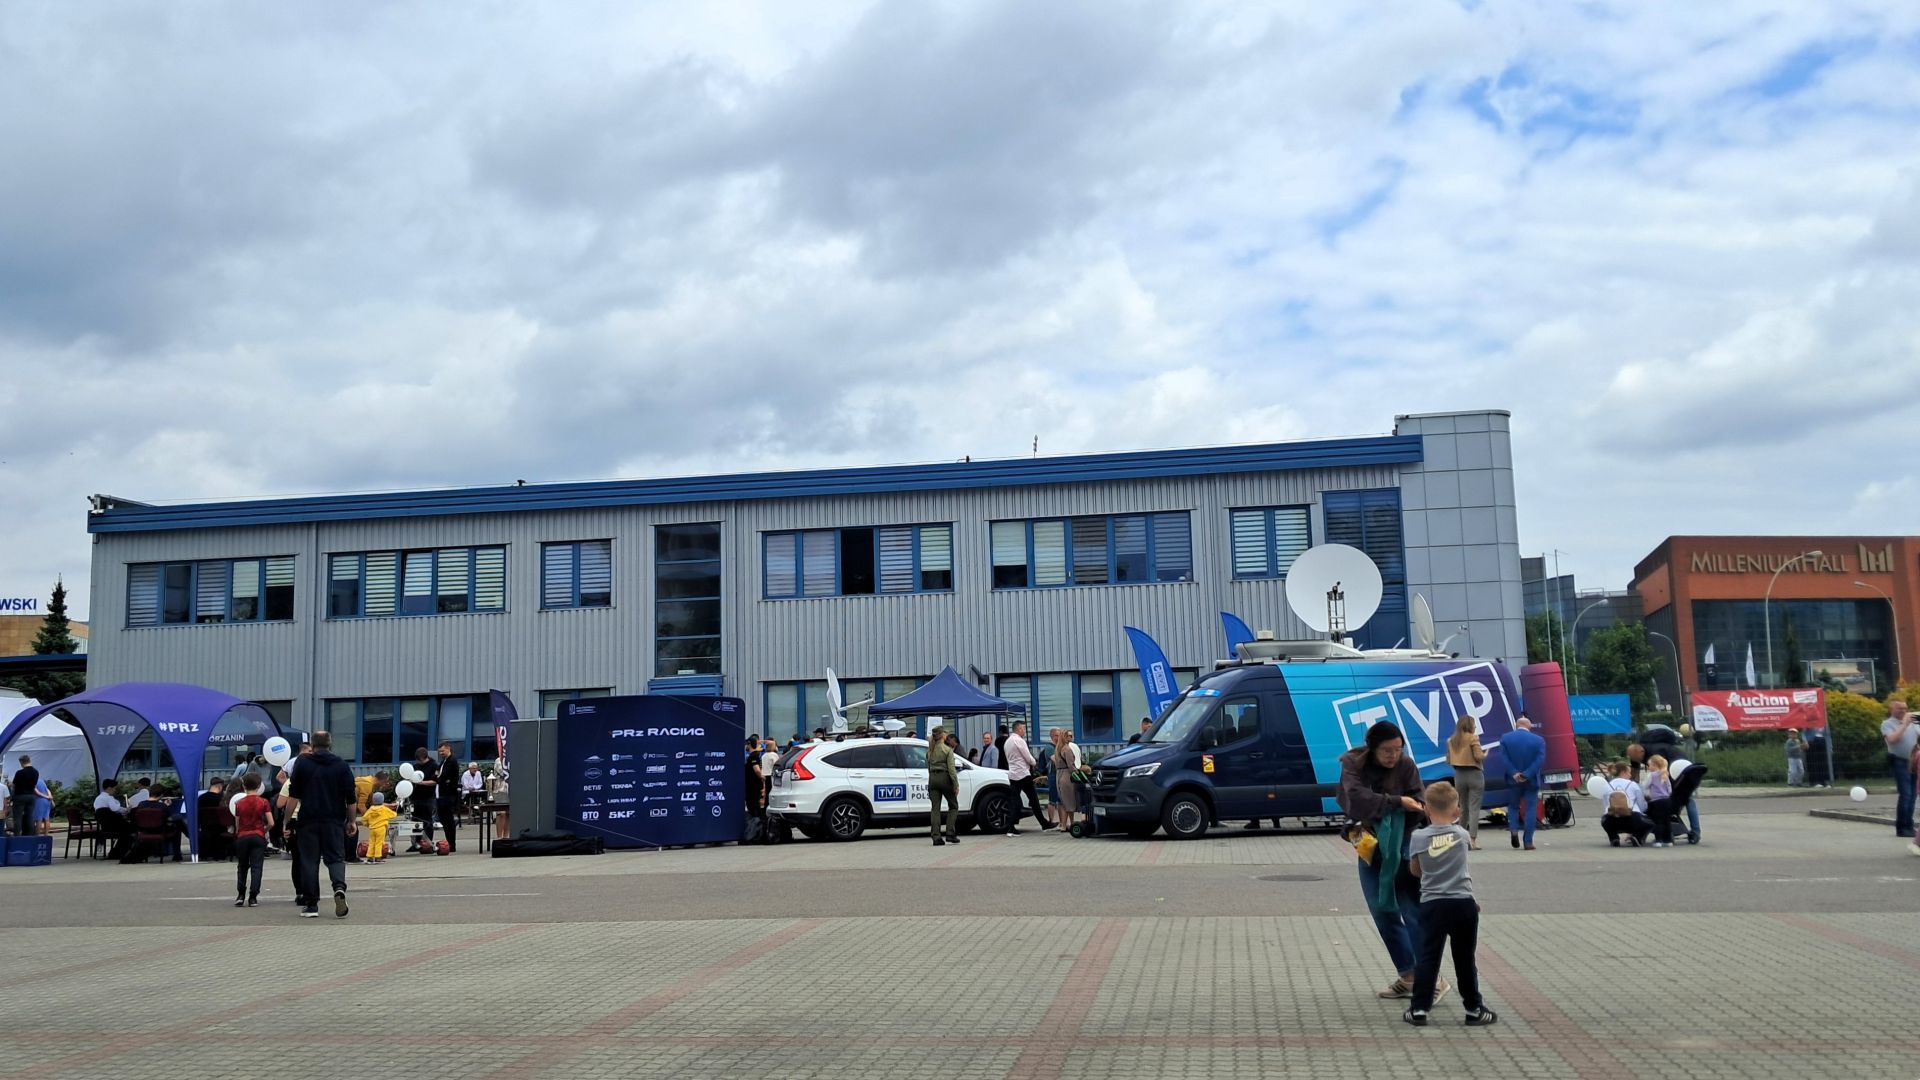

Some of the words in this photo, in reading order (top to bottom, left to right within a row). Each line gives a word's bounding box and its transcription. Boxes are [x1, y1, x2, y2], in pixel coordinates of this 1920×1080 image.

[0, 598, 37, 610] WSKI
[1728, 691, 1789, 707] Auchan
[158, 722, 200, 733] #PRz
[611, 729, 644, 738] PRz
[647, 727, 705, 737] RACING
[680, 792, 698, 801] LTS
[880, 789, 901, 798] TVP
[582, 811, 599, 820] BTO
[608, 810, 635, 819] SKF
